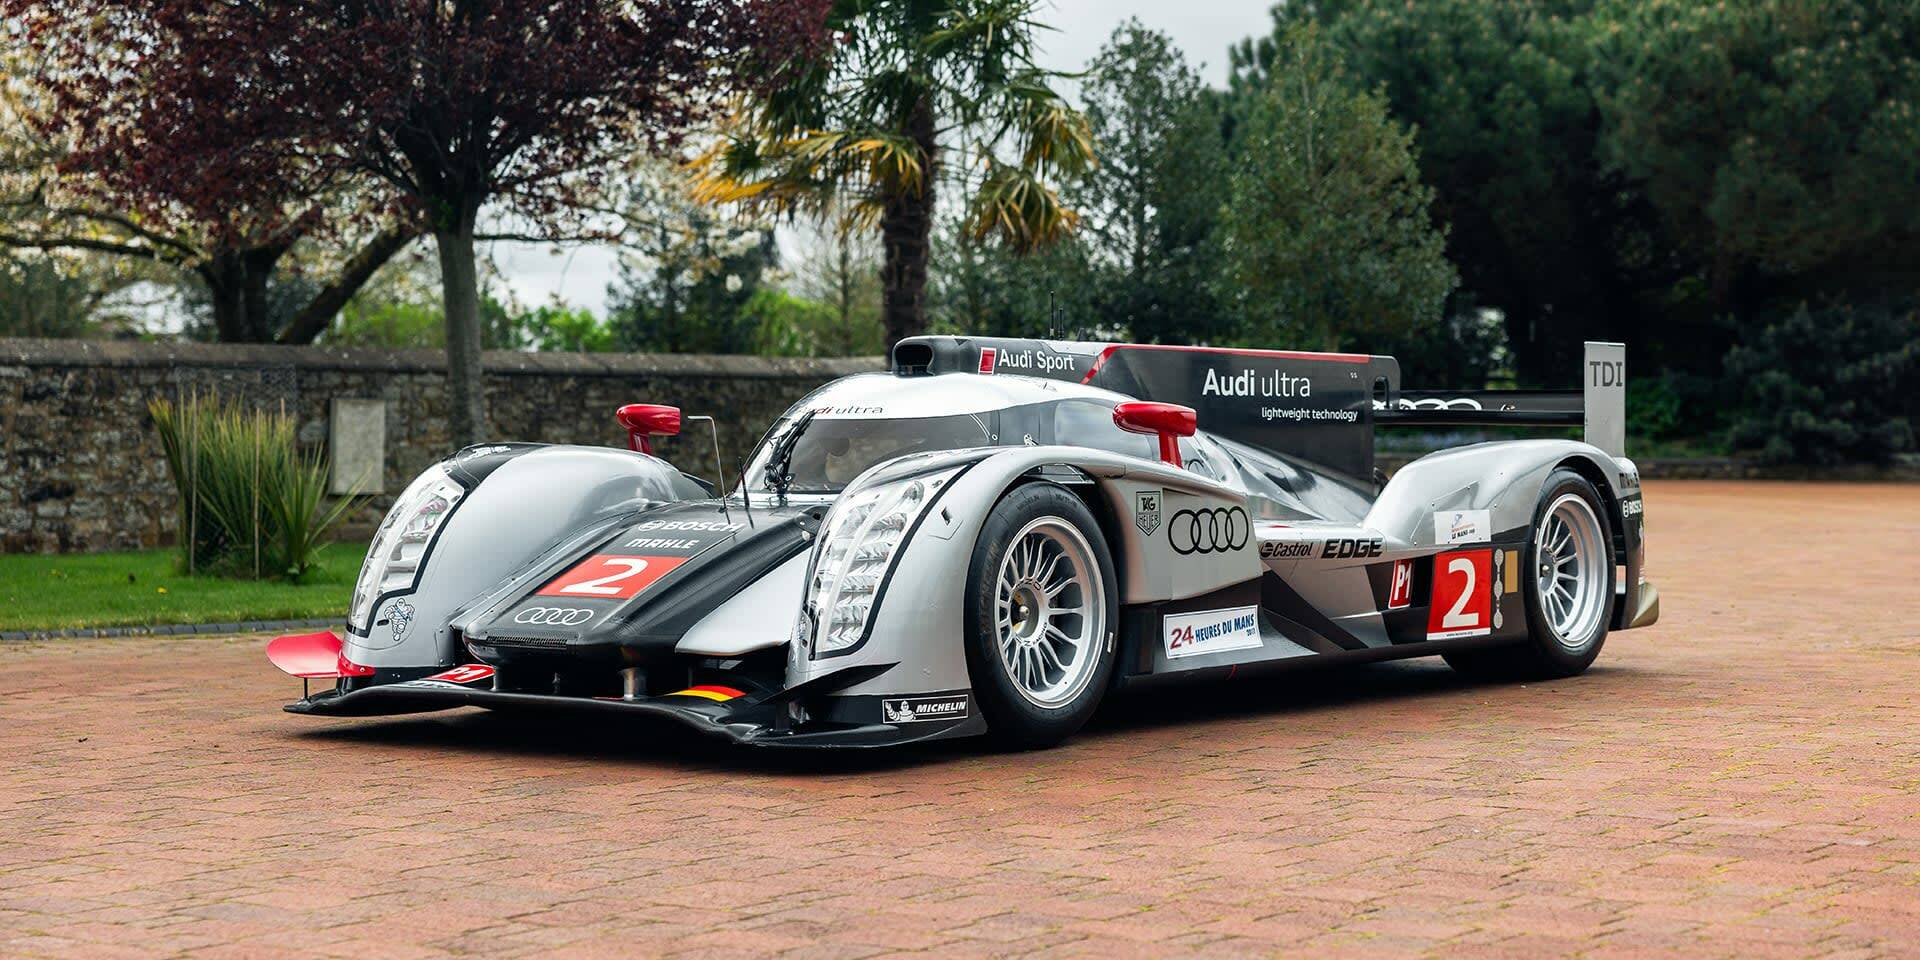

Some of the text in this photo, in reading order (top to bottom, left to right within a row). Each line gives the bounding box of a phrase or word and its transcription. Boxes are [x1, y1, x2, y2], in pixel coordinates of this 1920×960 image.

[999, 349, 1074, 373] Audi Sport
[1202, 368, 1311, 397] Audi ultra
[1590, 361, 1623, 387] TDI
[835, 405, 883, 414] ultra
[1261, 407, 1359, 422] lightweight technology
[660, 521, 745, 532] BOSCH
[624, 537, 700, 550] MAHLE
[1272, 538, 1384, 559] Castrol EDGE
[559, 558, 648, 594] 2
[1394, 563, 1411, 601] P1
[1442, 558, 1479, 628] 2
[1170, 613, 1255, 650] 24 HEURES DU MANS
[916, 701, 967, 713] MICHELIN
